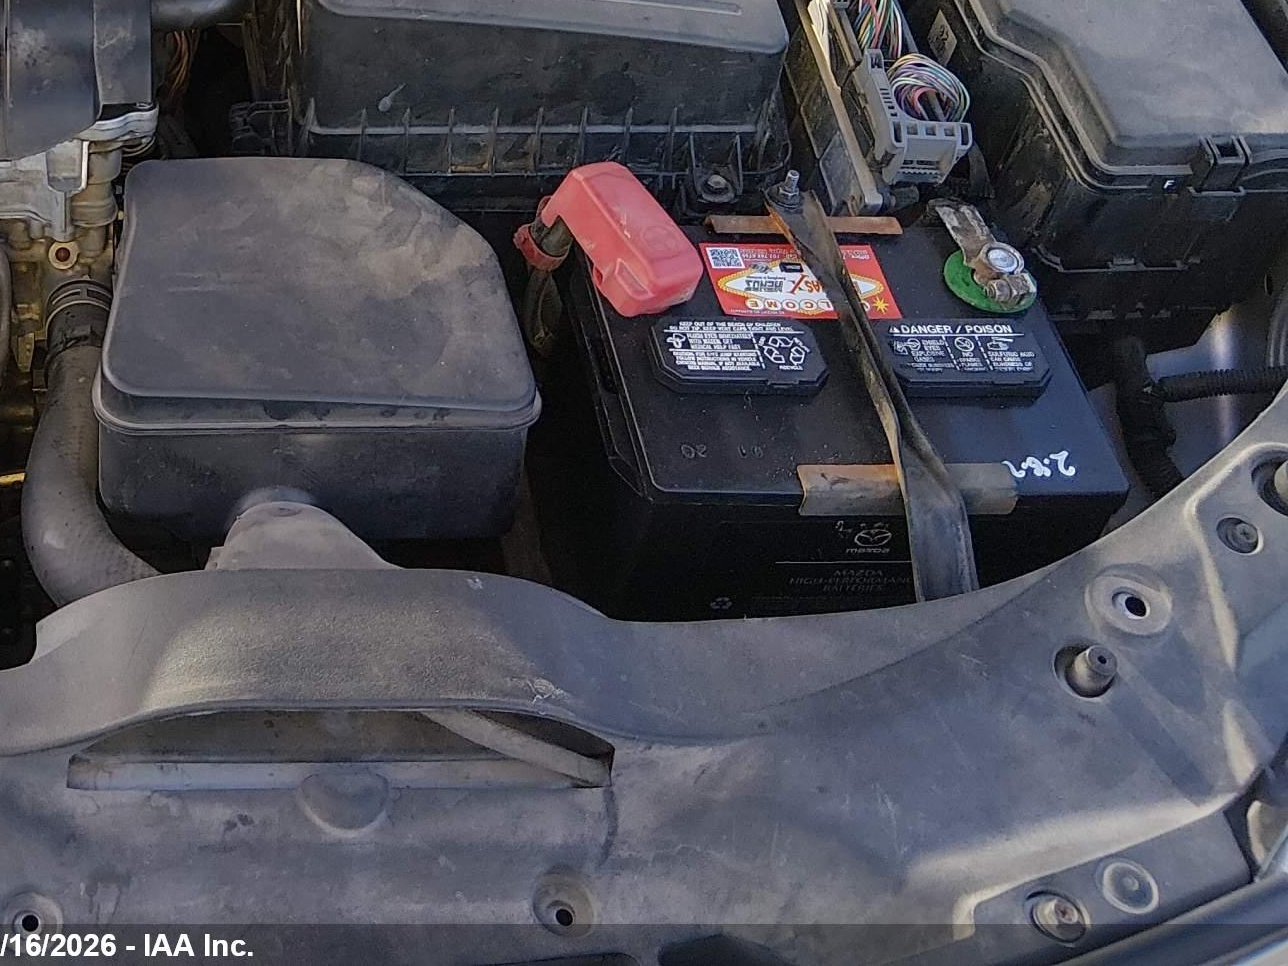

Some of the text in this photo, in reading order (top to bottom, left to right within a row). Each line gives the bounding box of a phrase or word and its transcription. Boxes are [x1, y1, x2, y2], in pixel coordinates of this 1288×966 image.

[1163, 180, 1175, 189] F
[900, 324, 952, 334] DANGER
[965, 324, 1013, 333] POISON
